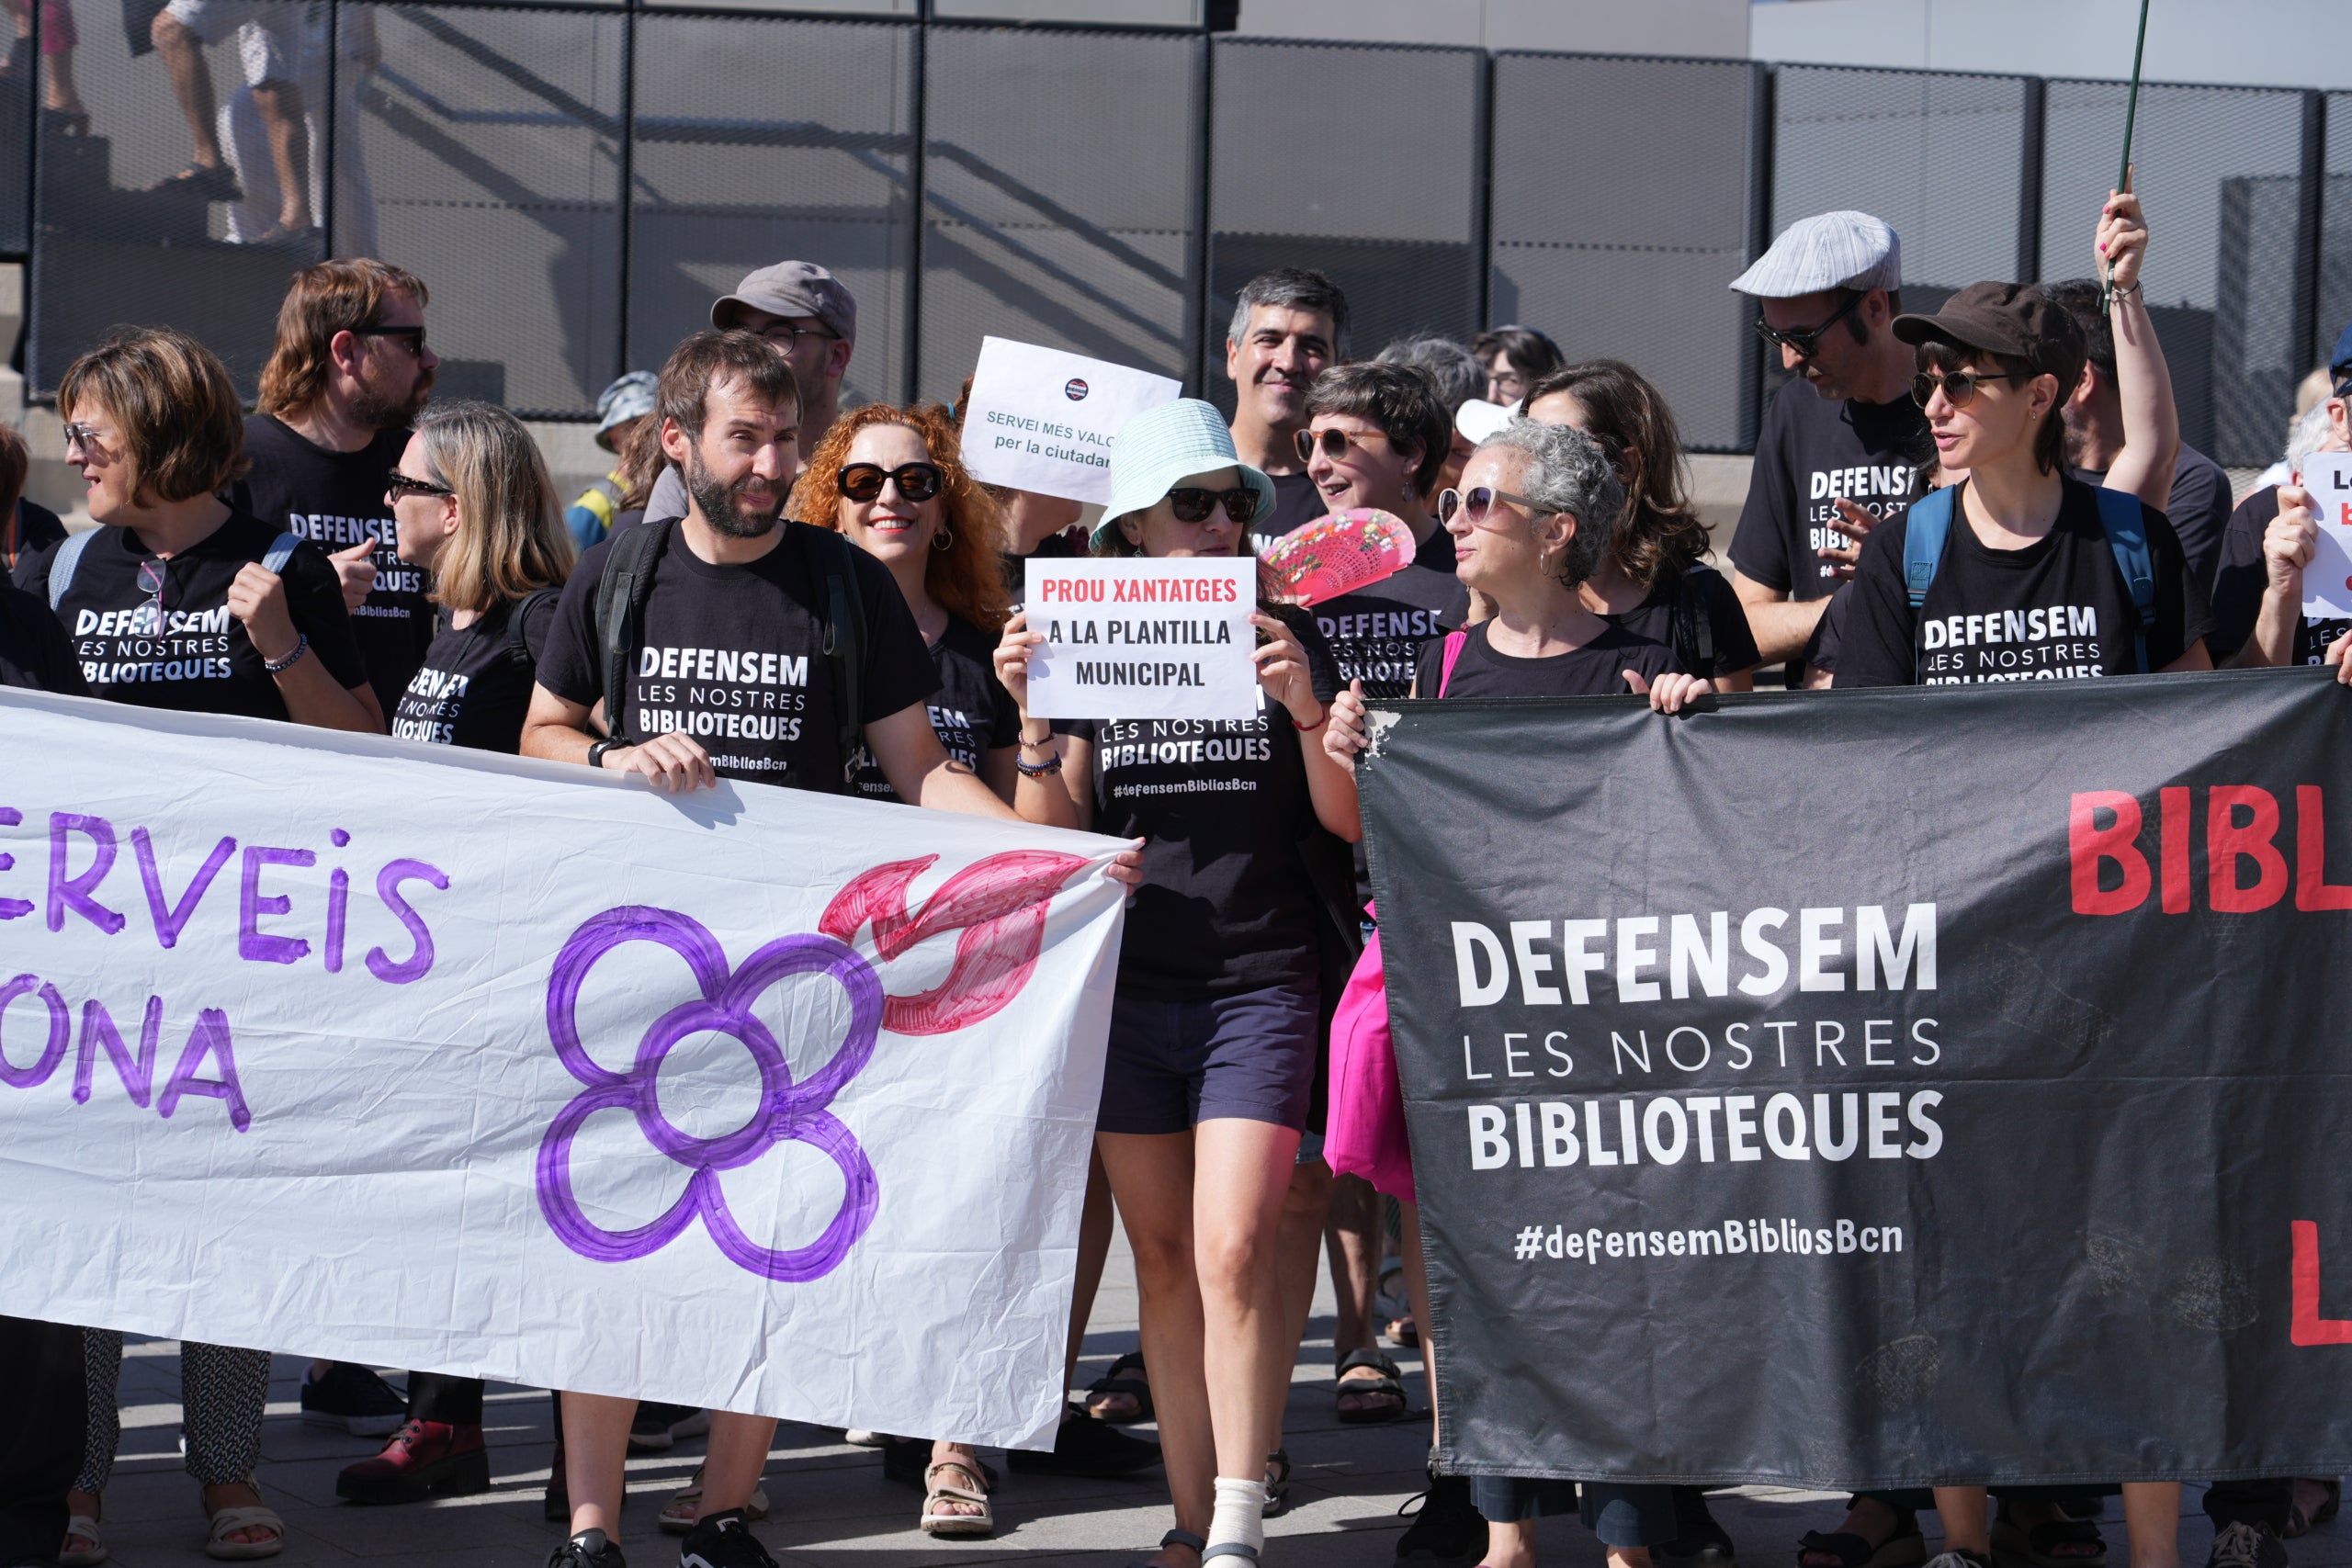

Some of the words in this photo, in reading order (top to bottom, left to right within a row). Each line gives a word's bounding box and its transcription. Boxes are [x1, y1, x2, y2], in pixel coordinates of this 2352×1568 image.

[987, 411, 1039, 433] SERVEI
[994, 435, 1023, 449] per
[1026, 439, 1040, 455] la
[1810, 504, 1841, 522] LES
[1042, 579, 1104, 602] PROU
[1113, 578, 1238, 602] XANTATGES
[1048, 620, 1063, 643] A
[1070, 620, 1099, 644] LA
[1107, 620, 1231, 644] PLANTILLA
[1924, 605, 2098, 650] DEFENSEM
[72, 637, 107, 656] ES
[117, 636, 230, 658] NOSTRES
[1927, 653, 1964, 671] LES
[1979, 643, 2101, 668] NOSTRES
[79, 657, 232, 683] BLIOTEQUES
[639, 646, 808, 688] DEFENSEM
[1076, 661, 1205, 687] MUNICIPAL
[639, 684, 676, 703] LES
[690, 686, 806, 712] NOSTRES
[639, 707, 803, 741] BIBLIOTEQUES
[1101, 722, 1139, 743] LES
[1152, 716, 1269, 738] NOSTRES
[1101, 738, 1272, 773] BIBLIOTEQUES
[1113, 777, 1258, 798] #defensemBibliosBcn
[2068, 784, 2352, 916] BIBL
[1451, 902, 1938, 1008] DEFENSEM
[1463, 1031, 1575, 1080] LES
[1611, 1018, 1941, 1076] NOSTRES
[1467, 1089, 1944, 1170] BIBLIOTEQUES
[1514, 1217, 1904, 1265] #defensemBibliosBcn
